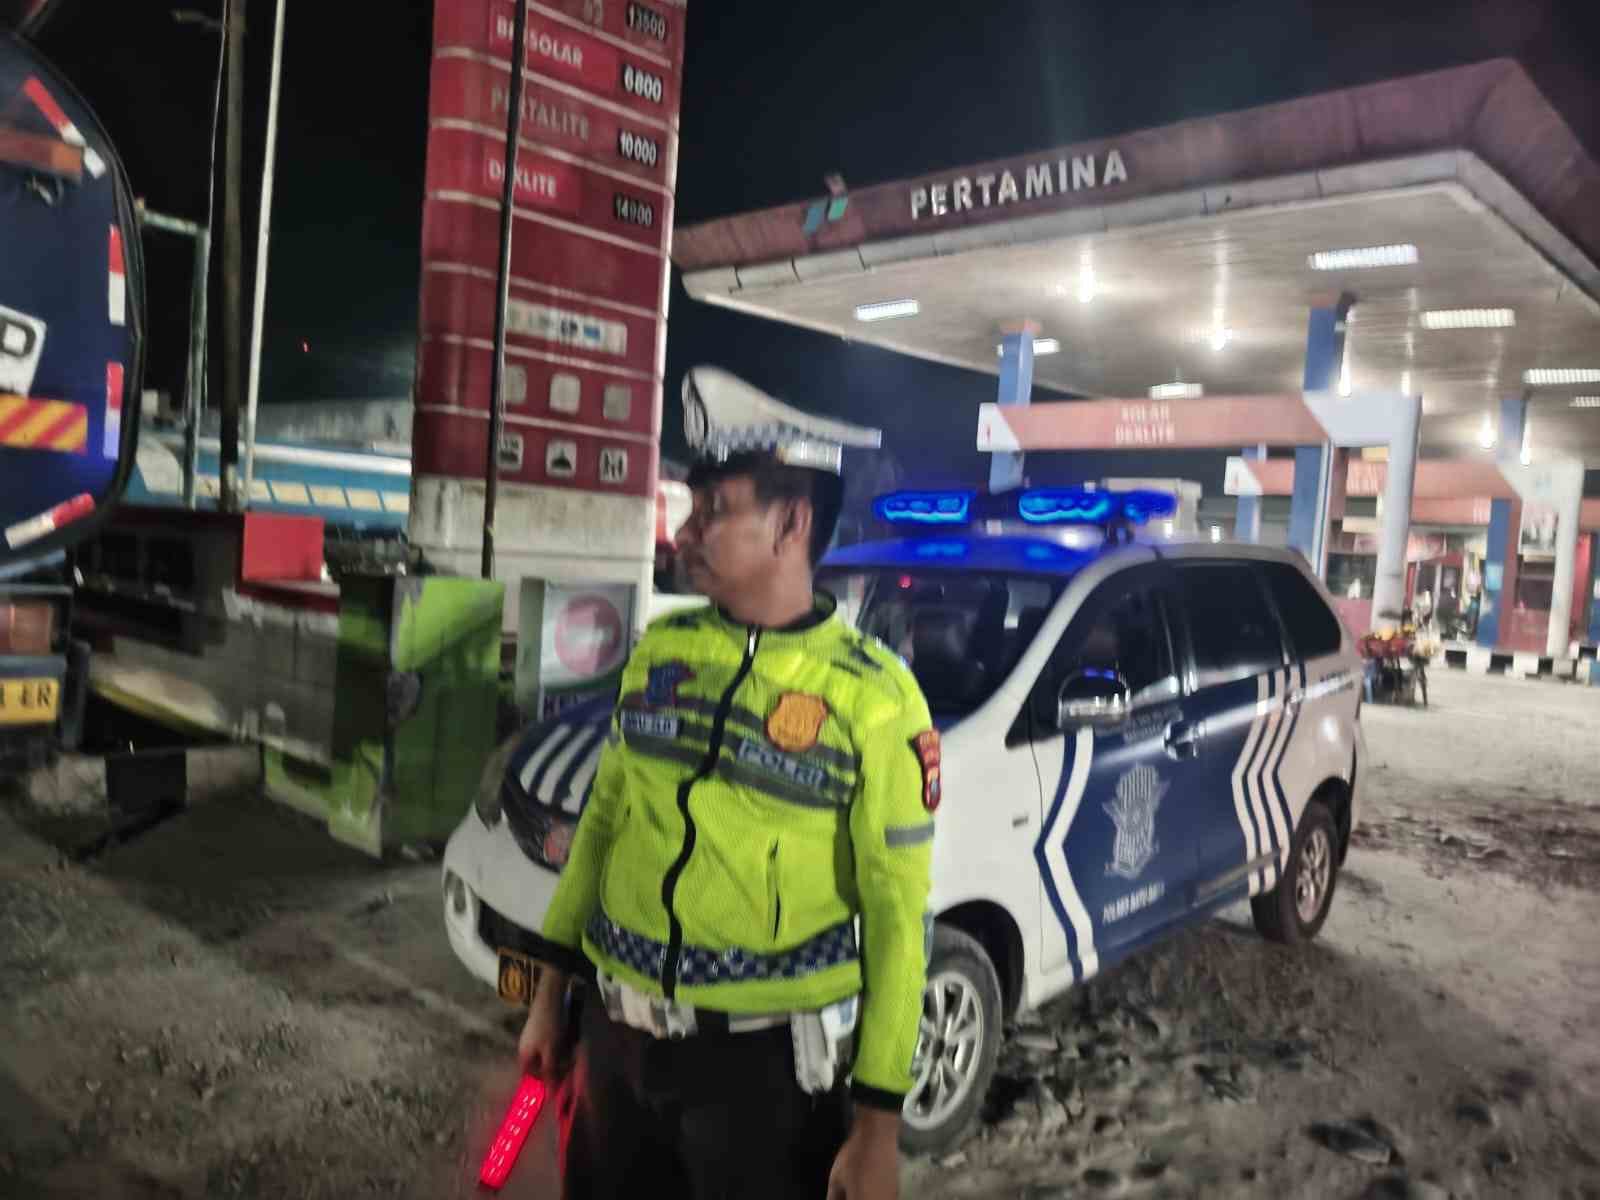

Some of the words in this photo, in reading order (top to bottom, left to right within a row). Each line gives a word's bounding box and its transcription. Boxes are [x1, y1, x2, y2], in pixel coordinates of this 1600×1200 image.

[623, 65, 662, 102] 6800
[488, 159, 557, 198] DXLITE
[910, 149, 1127, 221] PERTAMINA
